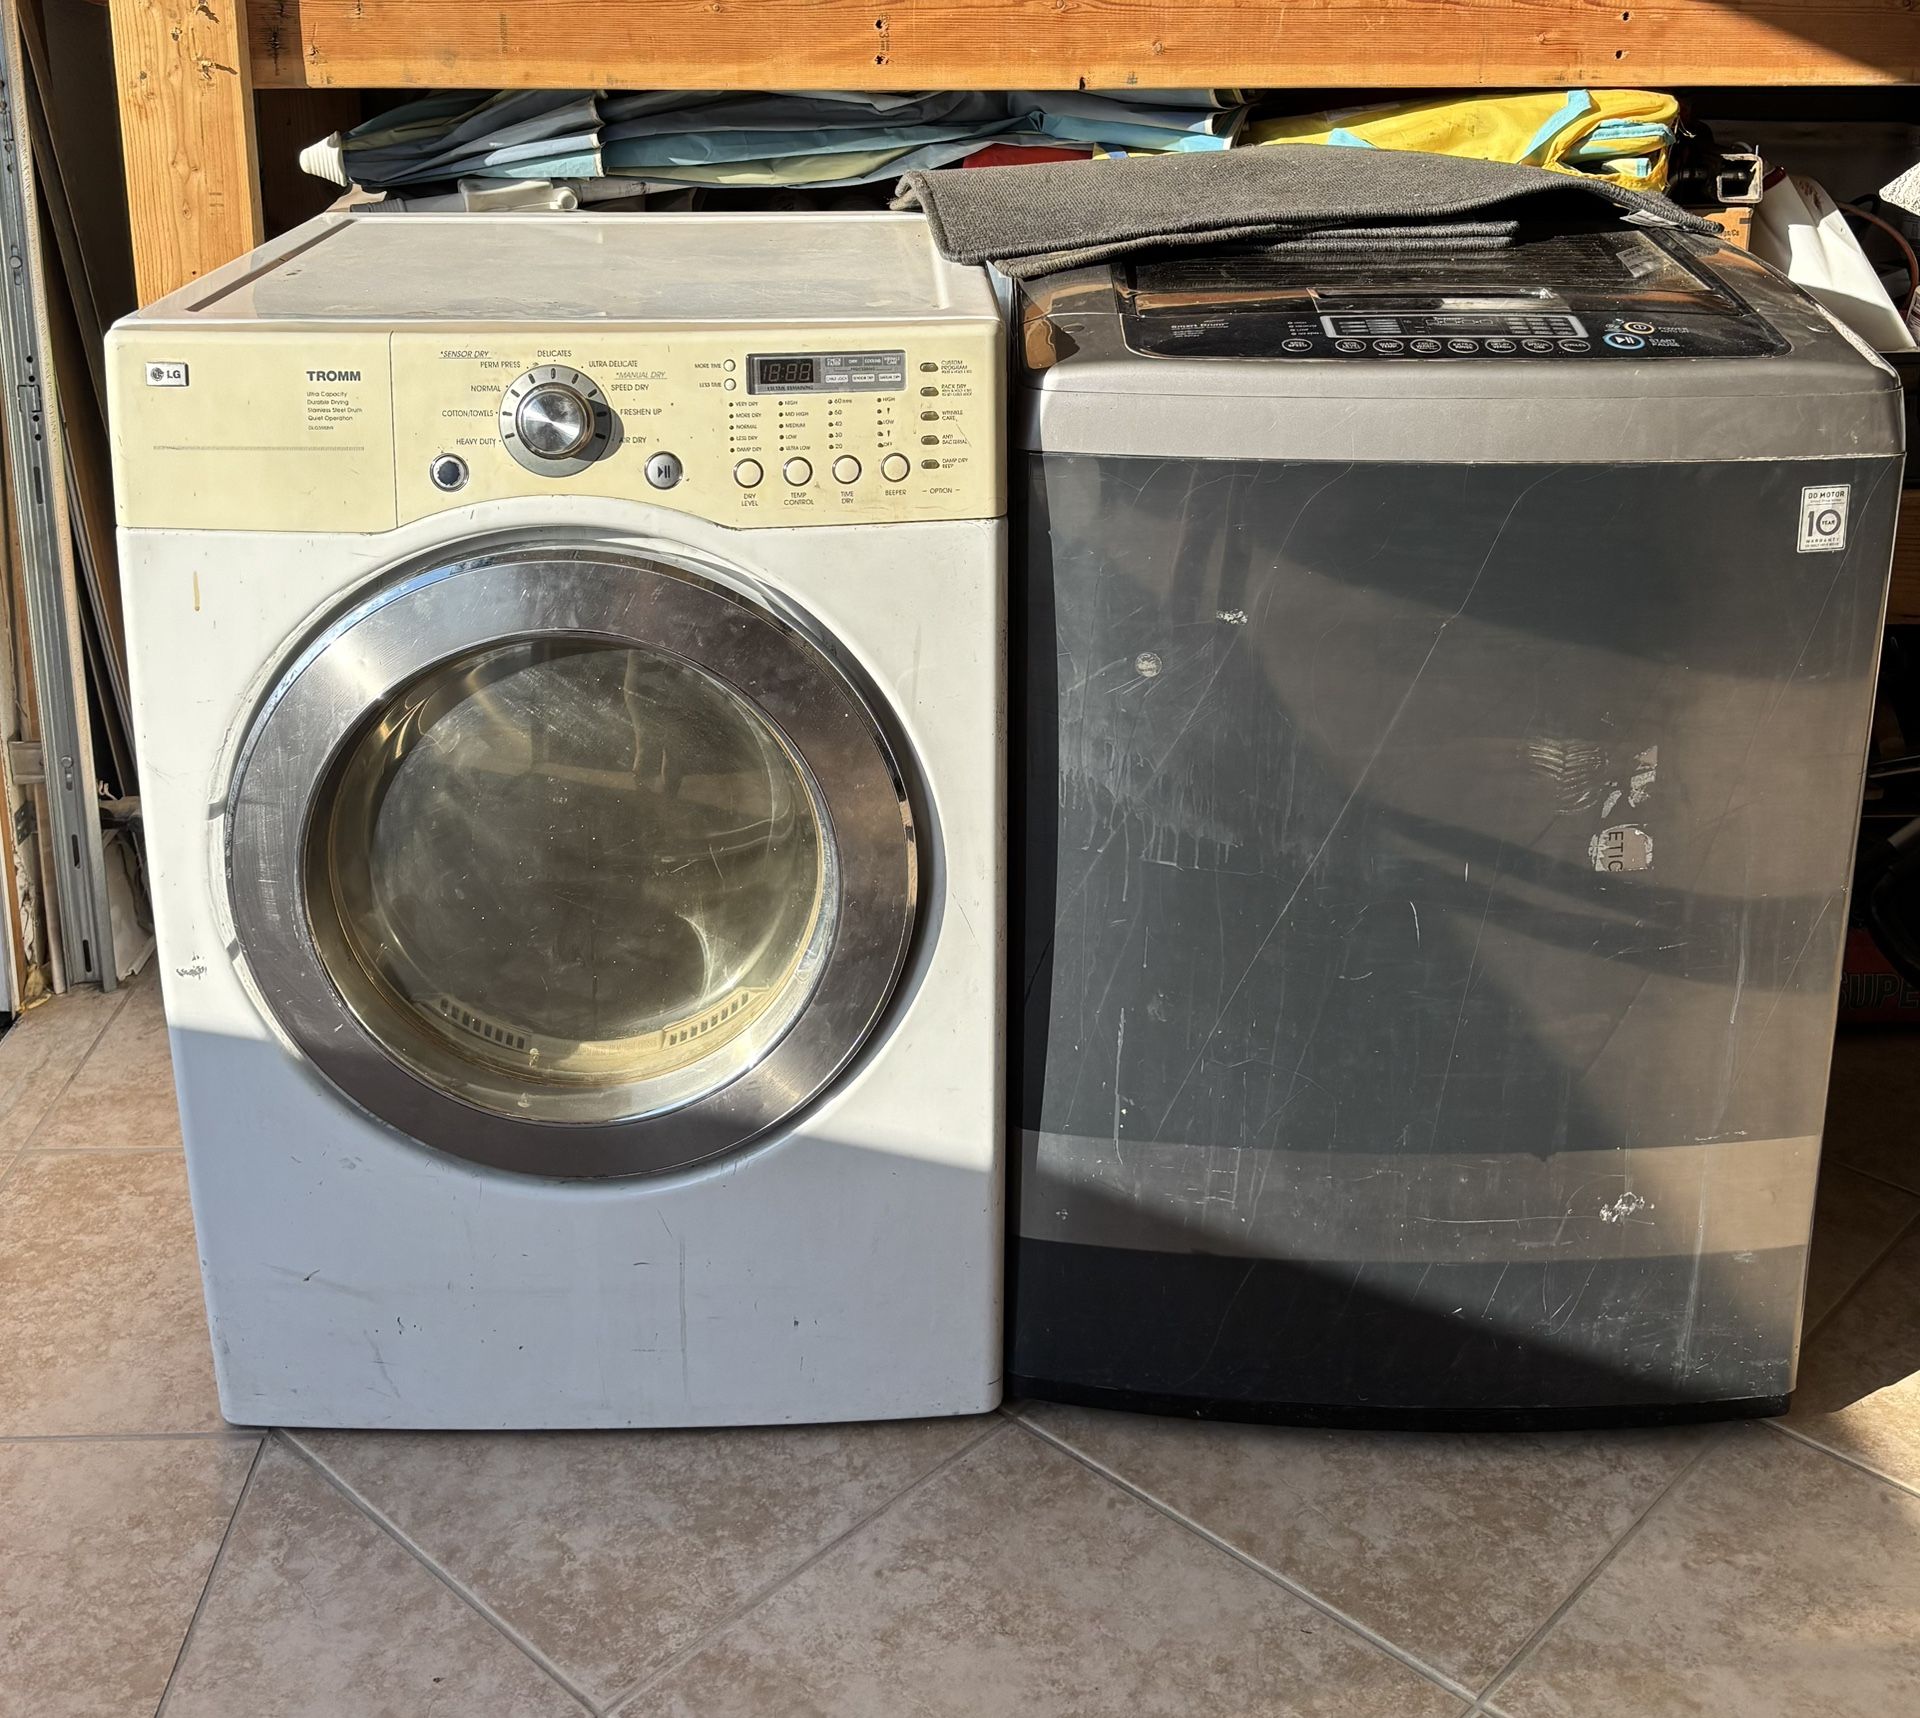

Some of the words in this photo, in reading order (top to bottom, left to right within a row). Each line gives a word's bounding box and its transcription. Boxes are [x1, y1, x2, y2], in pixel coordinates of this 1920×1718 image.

[474, 350, 489, 358] DRY
[166, 369, 181, 379] LG
[306, 371, 361, 381] TROMM
[650, 371, 666, 379] DRY
[470, 385, 501, 393] NORMAL
[611, 384, 633, 392] SPEED
[620, 408, 651, 416] FRESHEN
[456, 438, 478, 446] HEAVY
[479, 438, 496, 446] DUTY
[1820, 490, 1845, 499] MOTOR
[1808, 509, 1841, 537] 10
